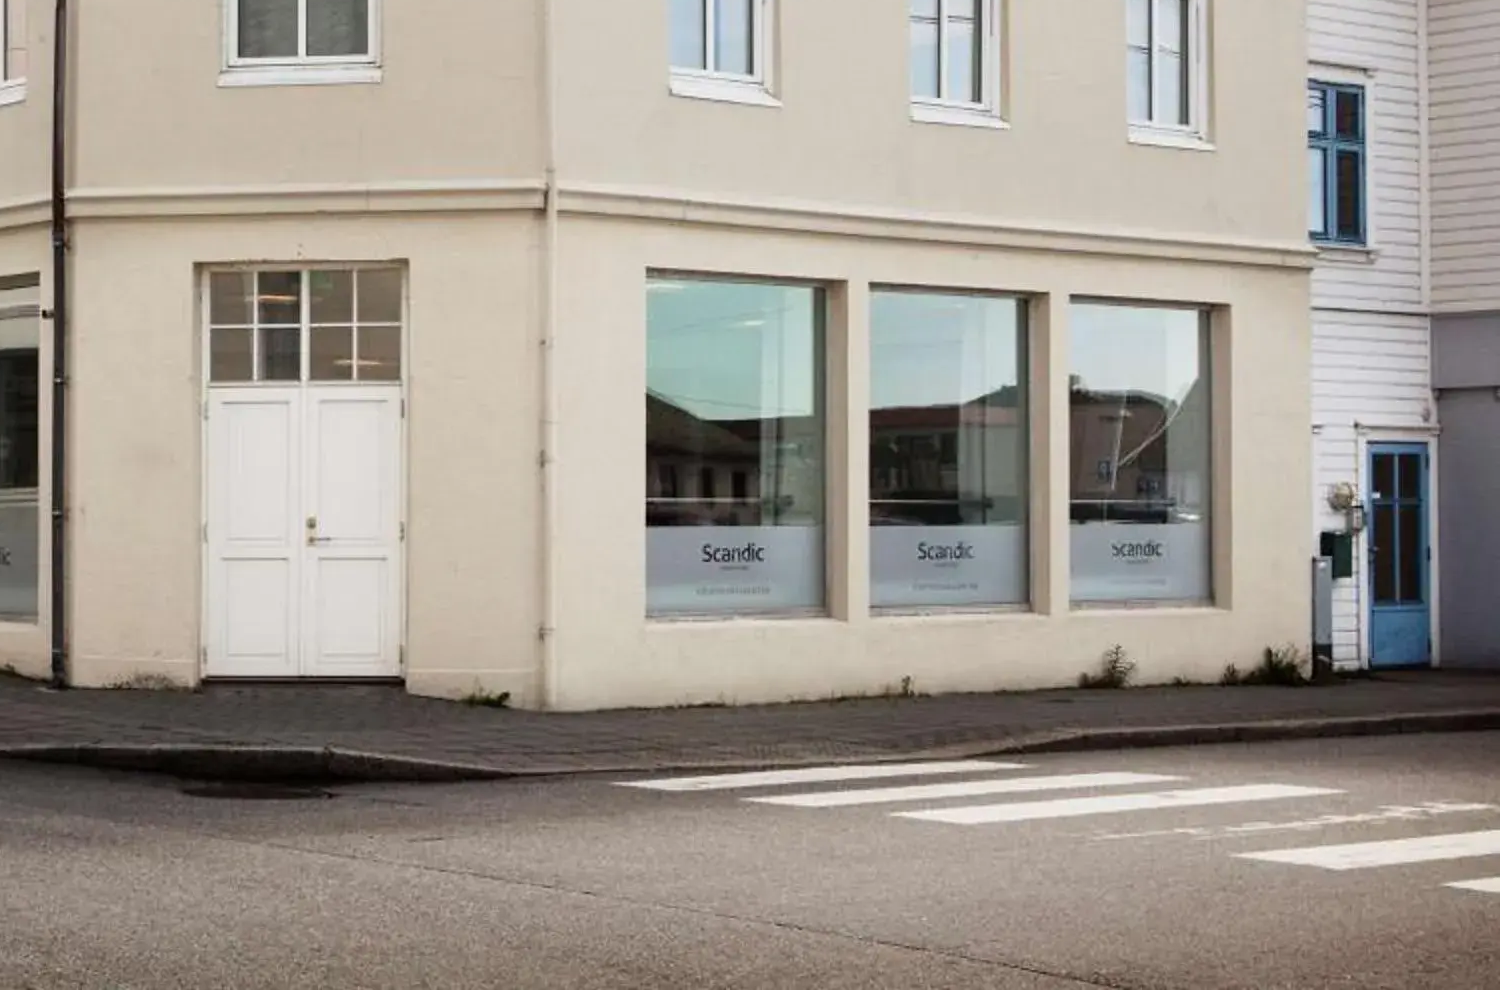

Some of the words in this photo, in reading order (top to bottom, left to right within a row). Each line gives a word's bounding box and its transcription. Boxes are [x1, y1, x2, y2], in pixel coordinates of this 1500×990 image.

[702, 542, 765, 562] Scandic
[917, 541, 975, 561] Scandic
[1111, 539, 1163, 557] Scandic
